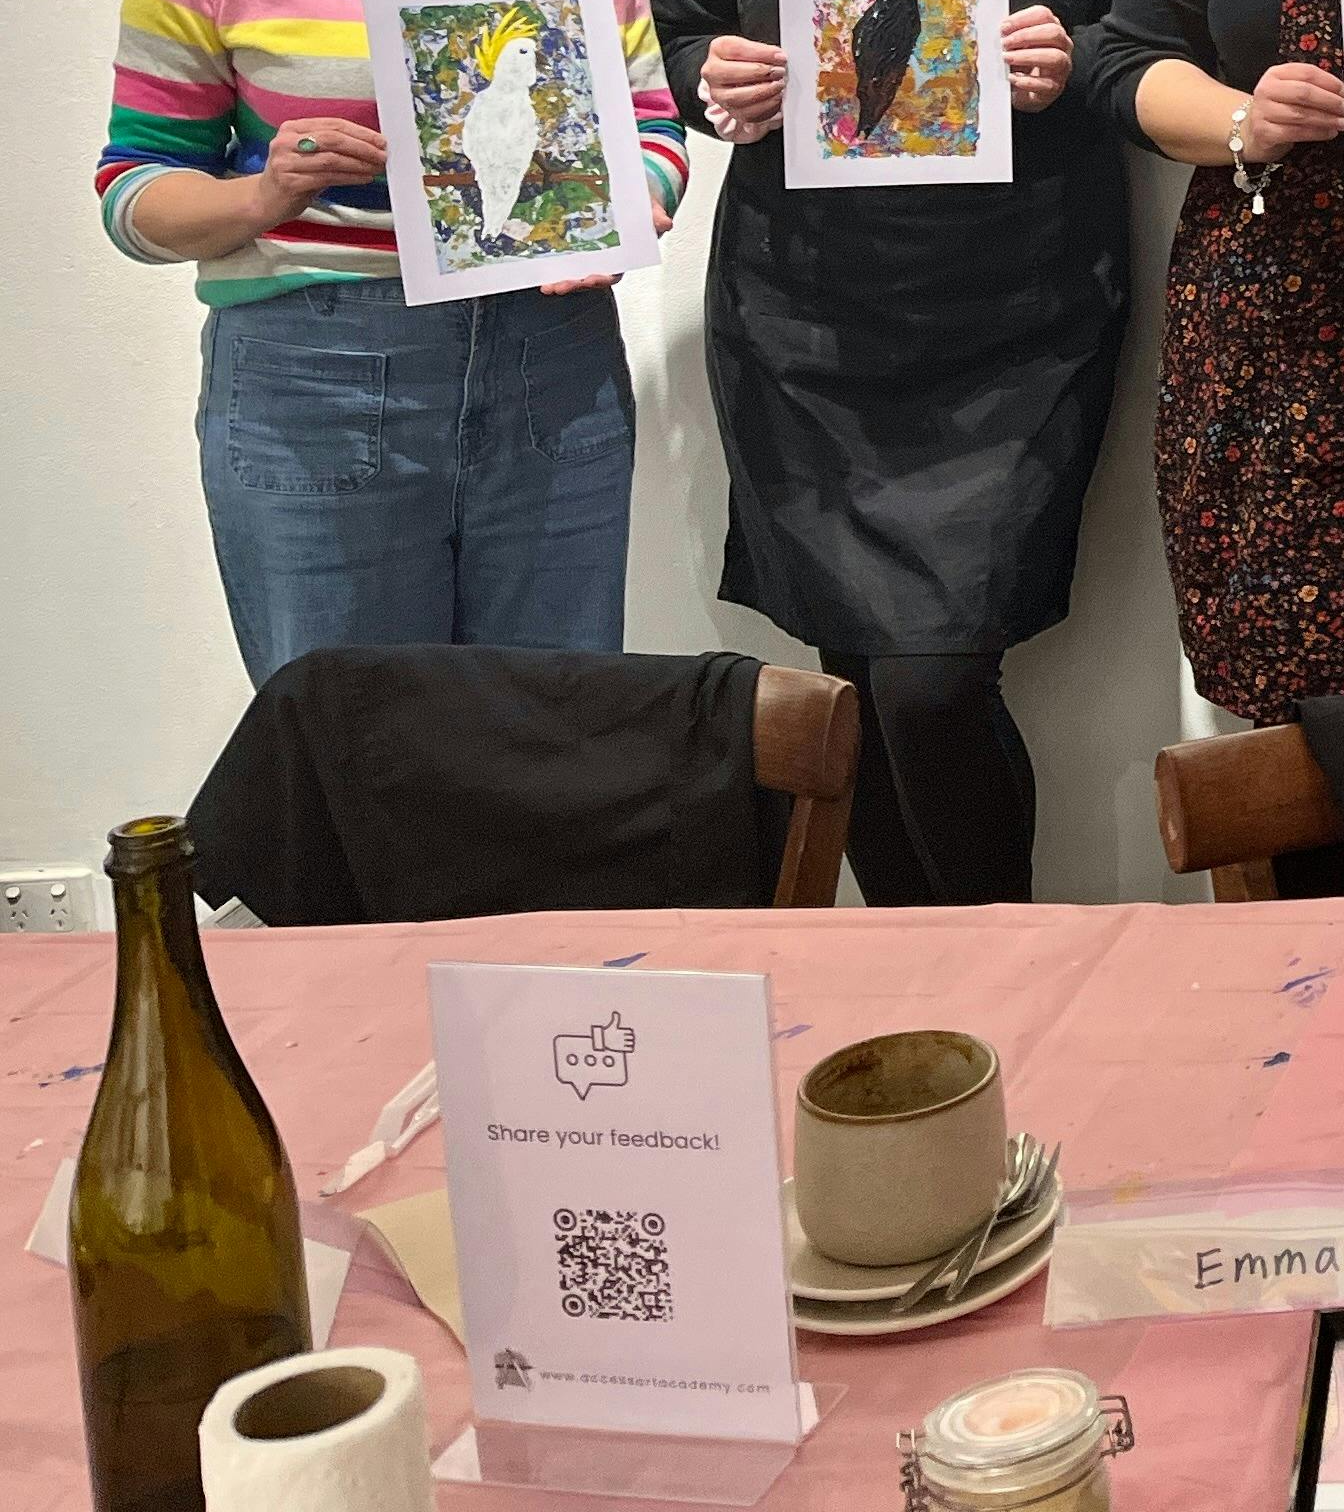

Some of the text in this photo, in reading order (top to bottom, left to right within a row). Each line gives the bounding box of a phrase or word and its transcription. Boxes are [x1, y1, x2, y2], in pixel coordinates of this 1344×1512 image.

[487, 1124, 721, 1151] Share your feedback!
[1194, 1244, 1341, 1290] Emma
